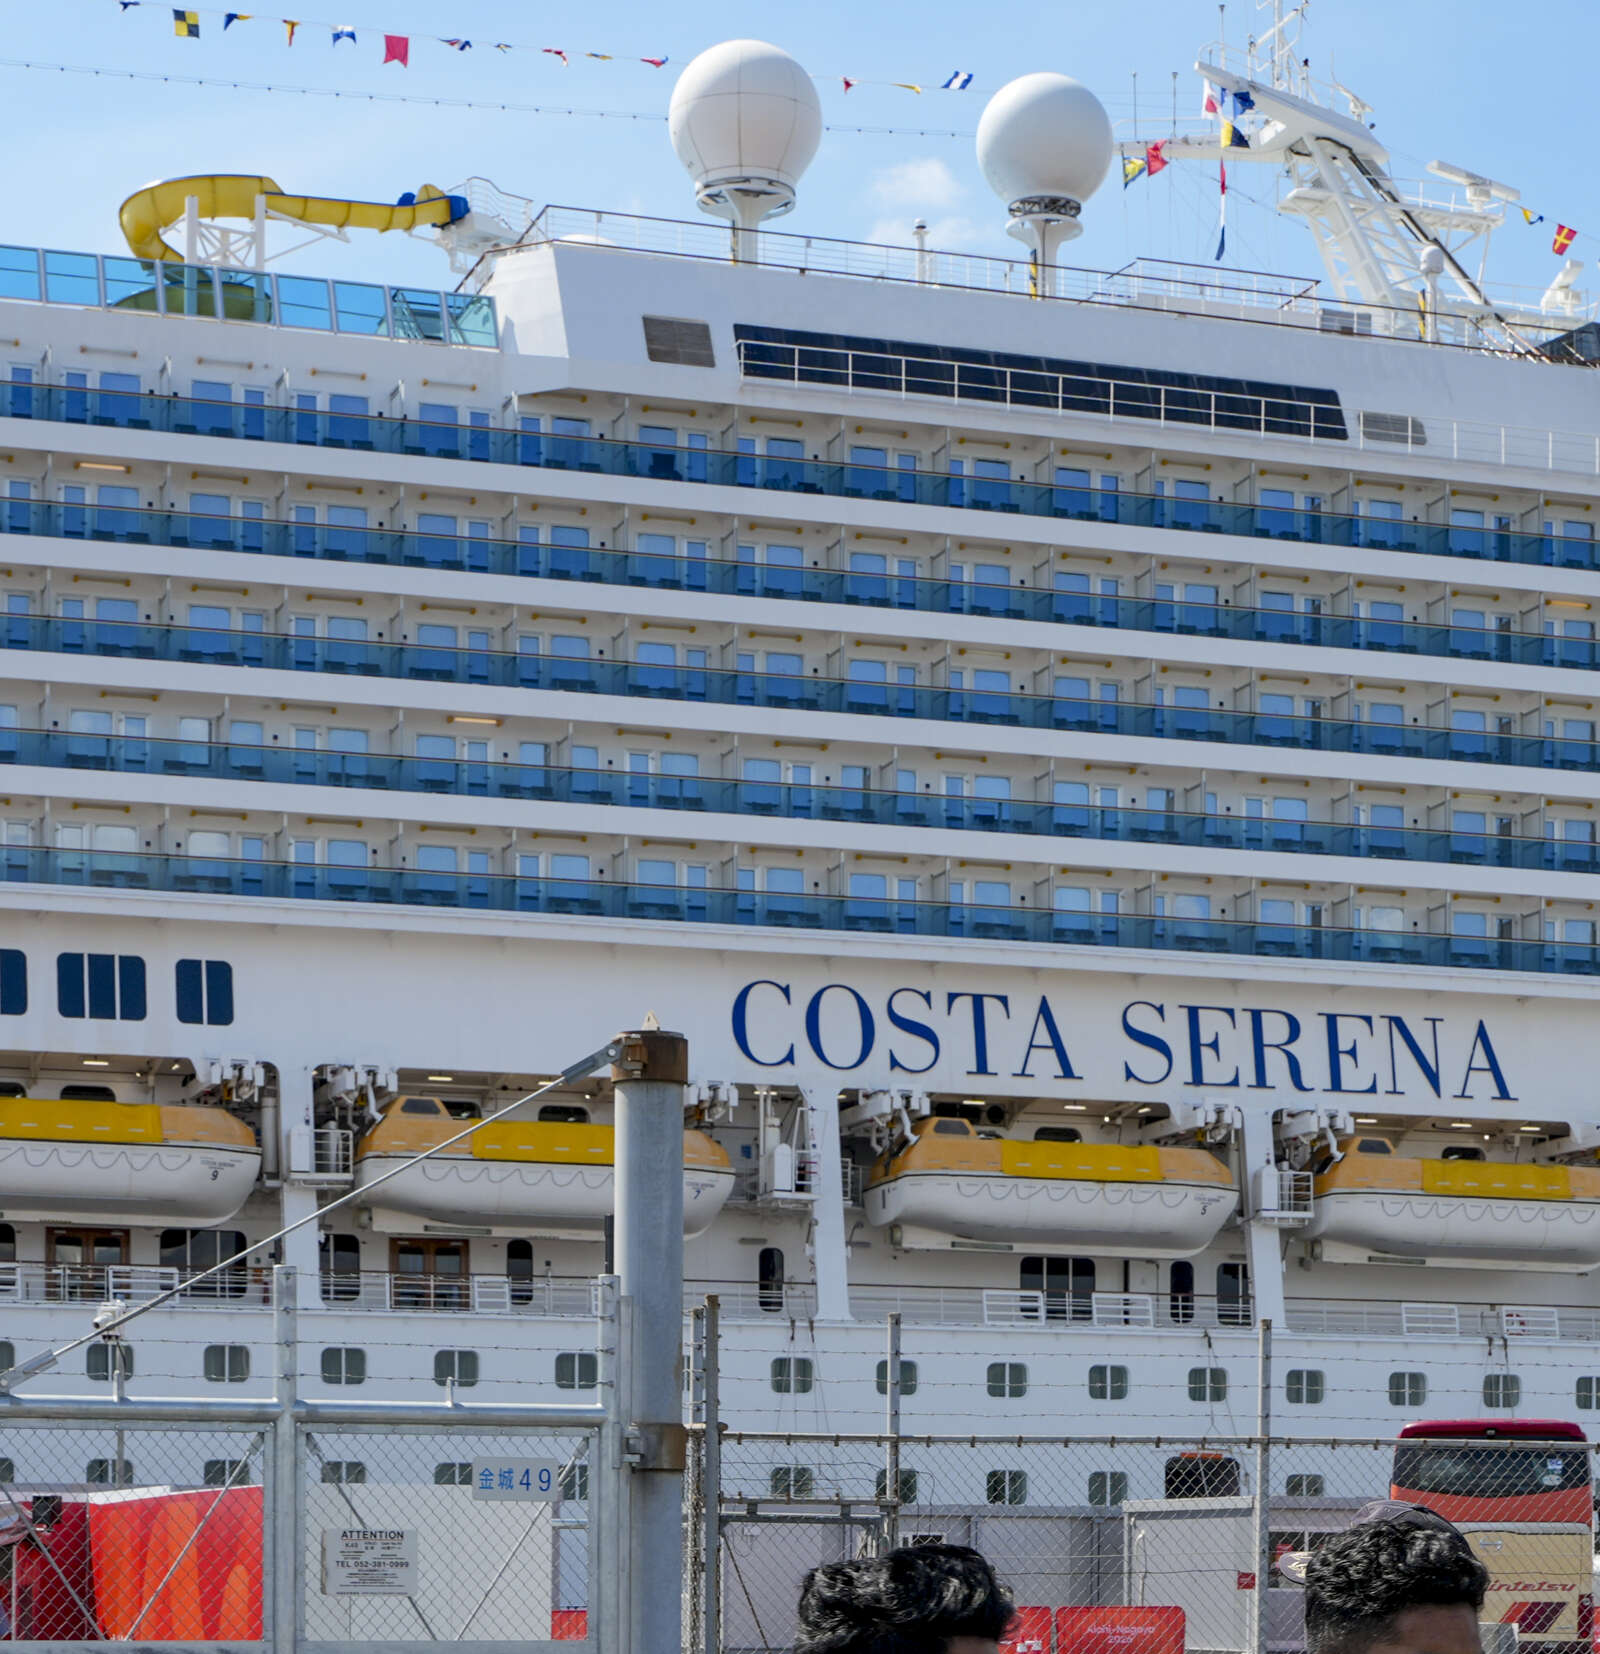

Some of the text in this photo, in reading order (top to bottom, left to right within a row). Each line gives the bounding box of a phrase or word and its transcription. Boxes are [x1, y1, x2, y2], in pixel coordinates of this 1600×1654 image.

[730, 979, 1518, 1102] COSTA SERENA
[210, 1169, 219, 1181] 9
[341, 1530, 404, 1540] ATTENTION
[1487, 1580, 1577, 1592] intetsu
